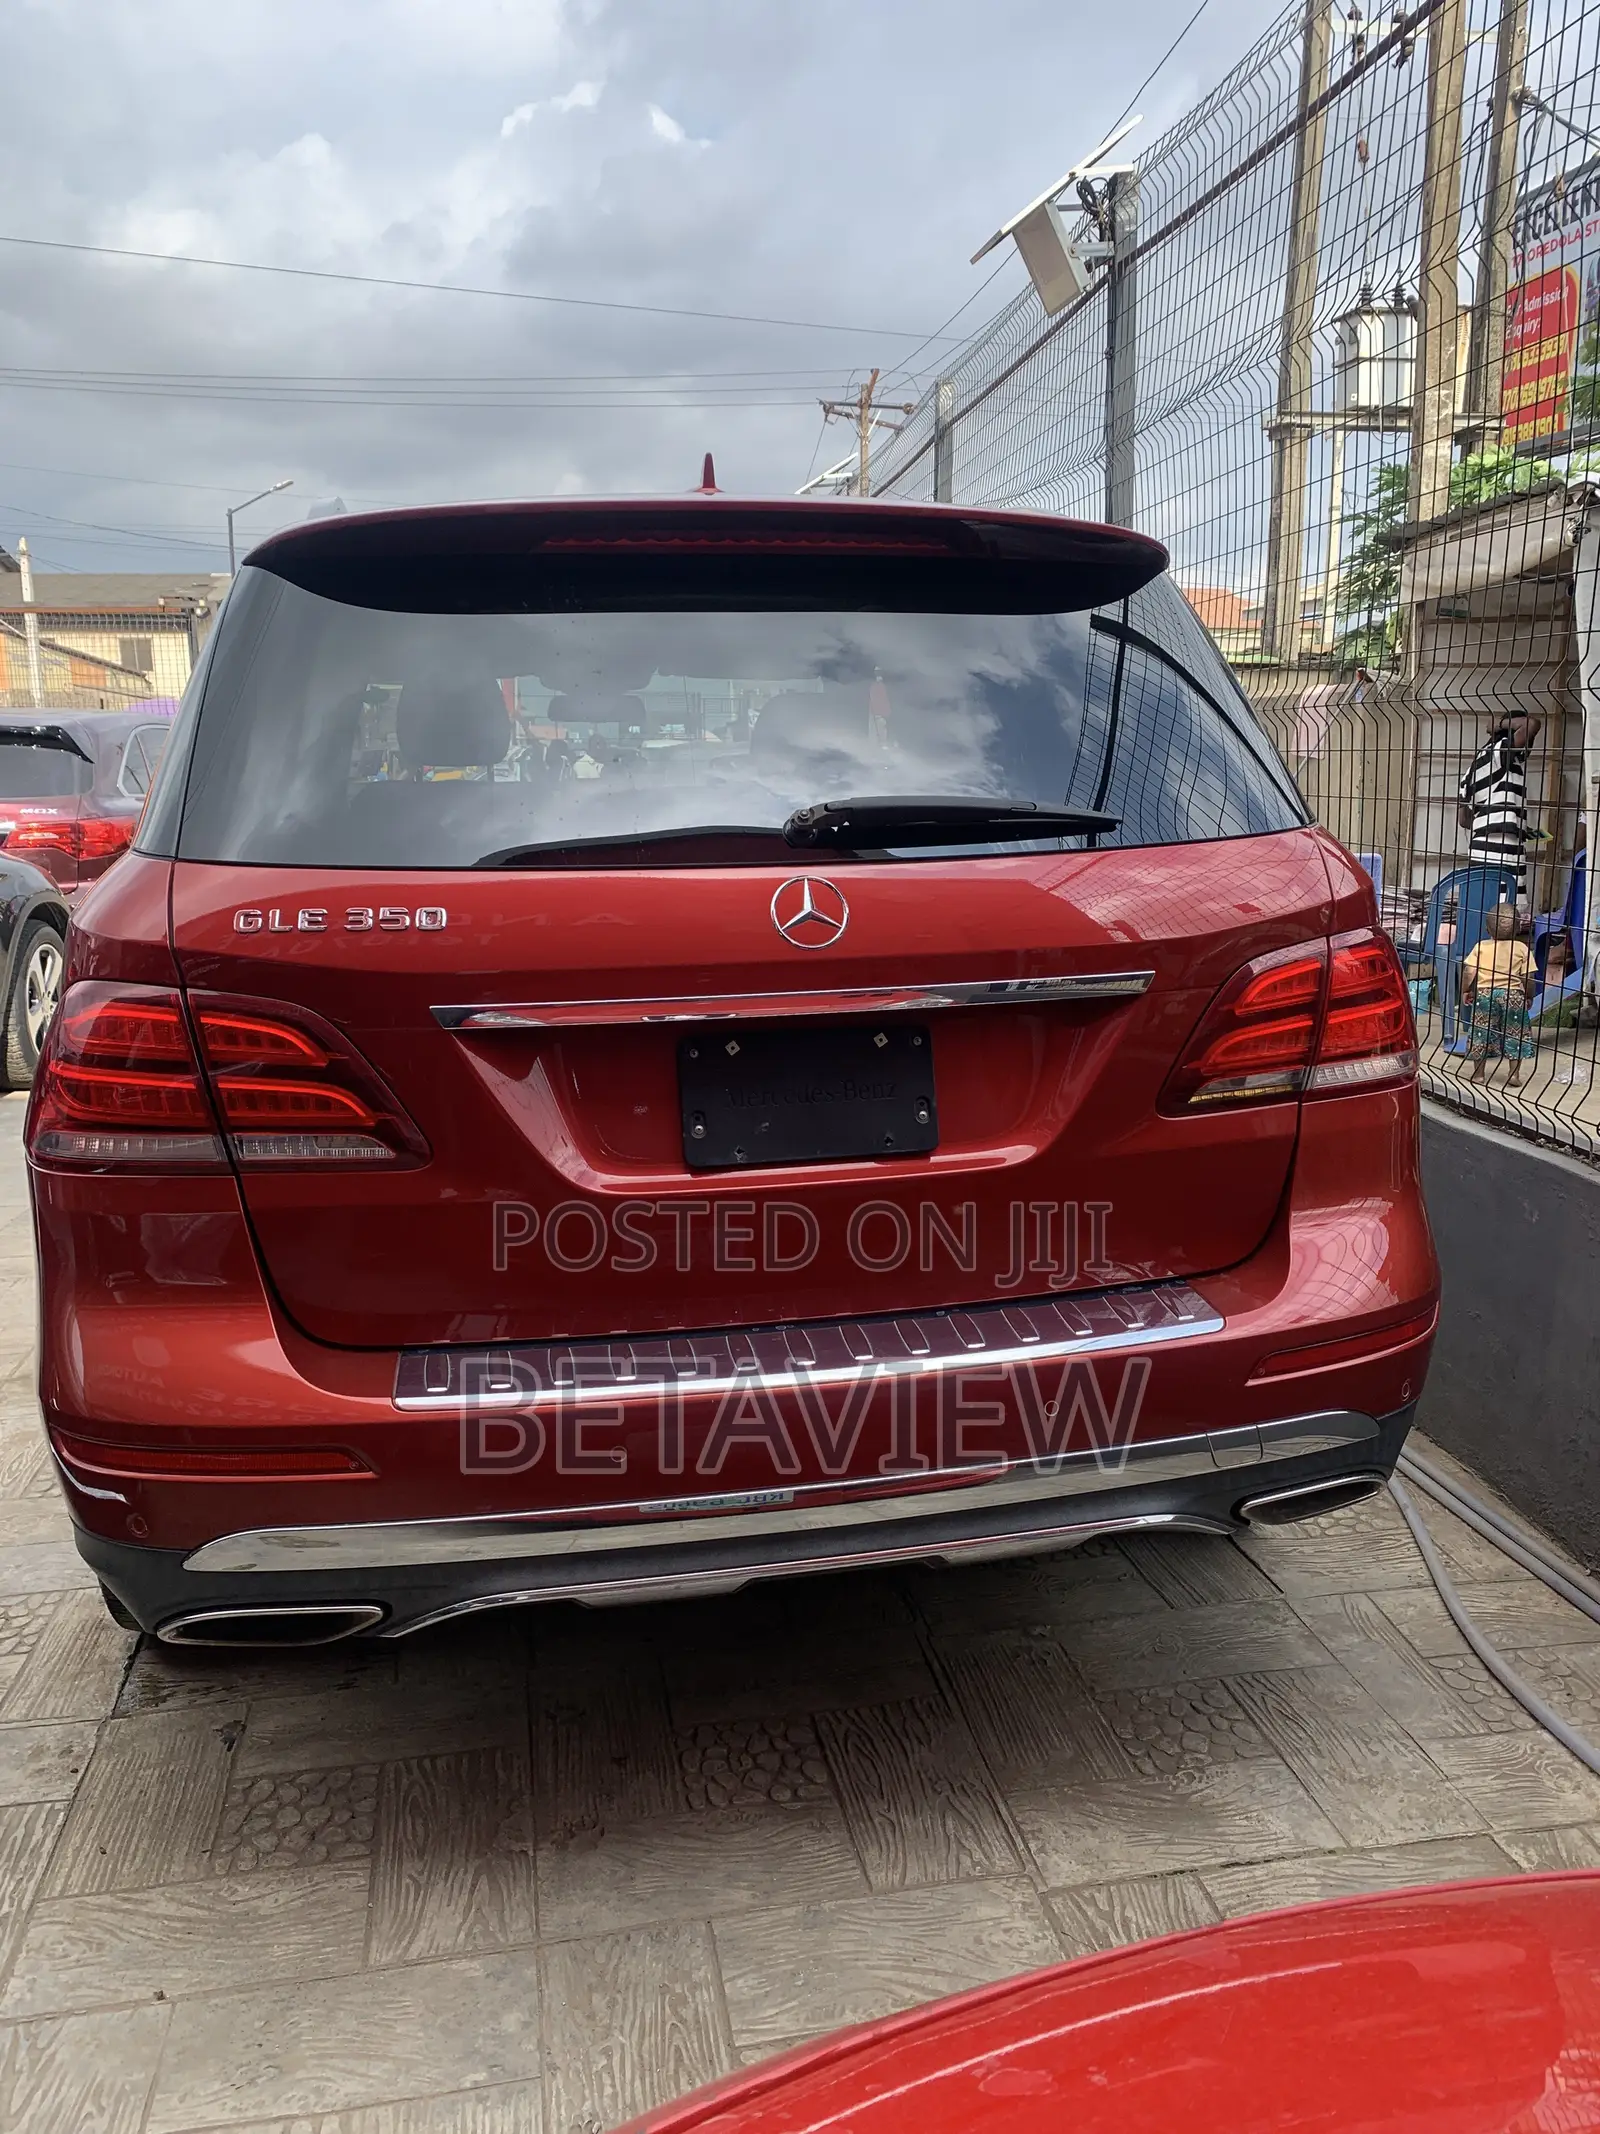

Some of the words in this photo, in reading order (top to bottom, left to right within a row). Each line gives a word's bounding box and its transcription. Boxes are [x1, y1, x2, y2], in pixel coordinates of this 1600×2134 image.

[1585, 218, 1600, 237] ST
[233, 908, 328, 933] GLE
[344, 906, 447, 931] 350
